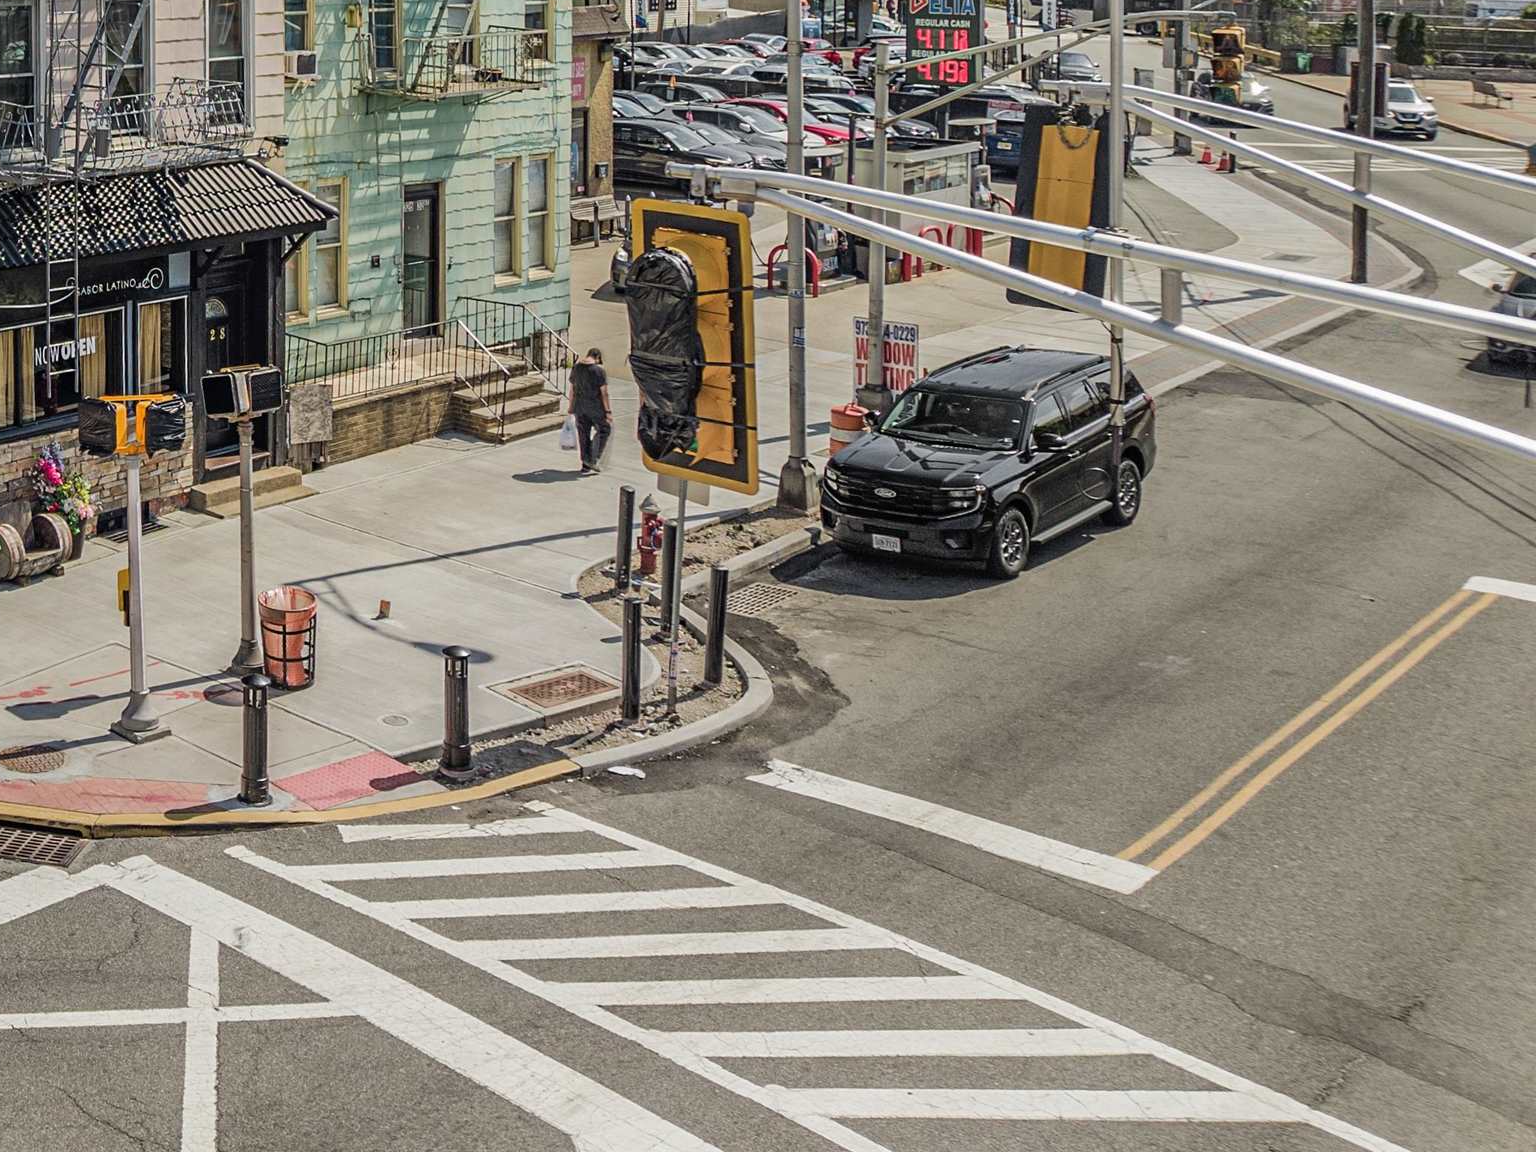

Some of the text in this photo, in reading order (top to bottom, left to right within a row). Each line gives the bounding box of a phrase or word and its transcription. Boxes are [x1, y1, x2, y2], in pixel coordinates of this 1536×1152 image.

[915, 18, 950, 28] REGULAR
[76, 278, 137, 296] SABOR LATINO
[855, 337, 916, 367] WDOW
